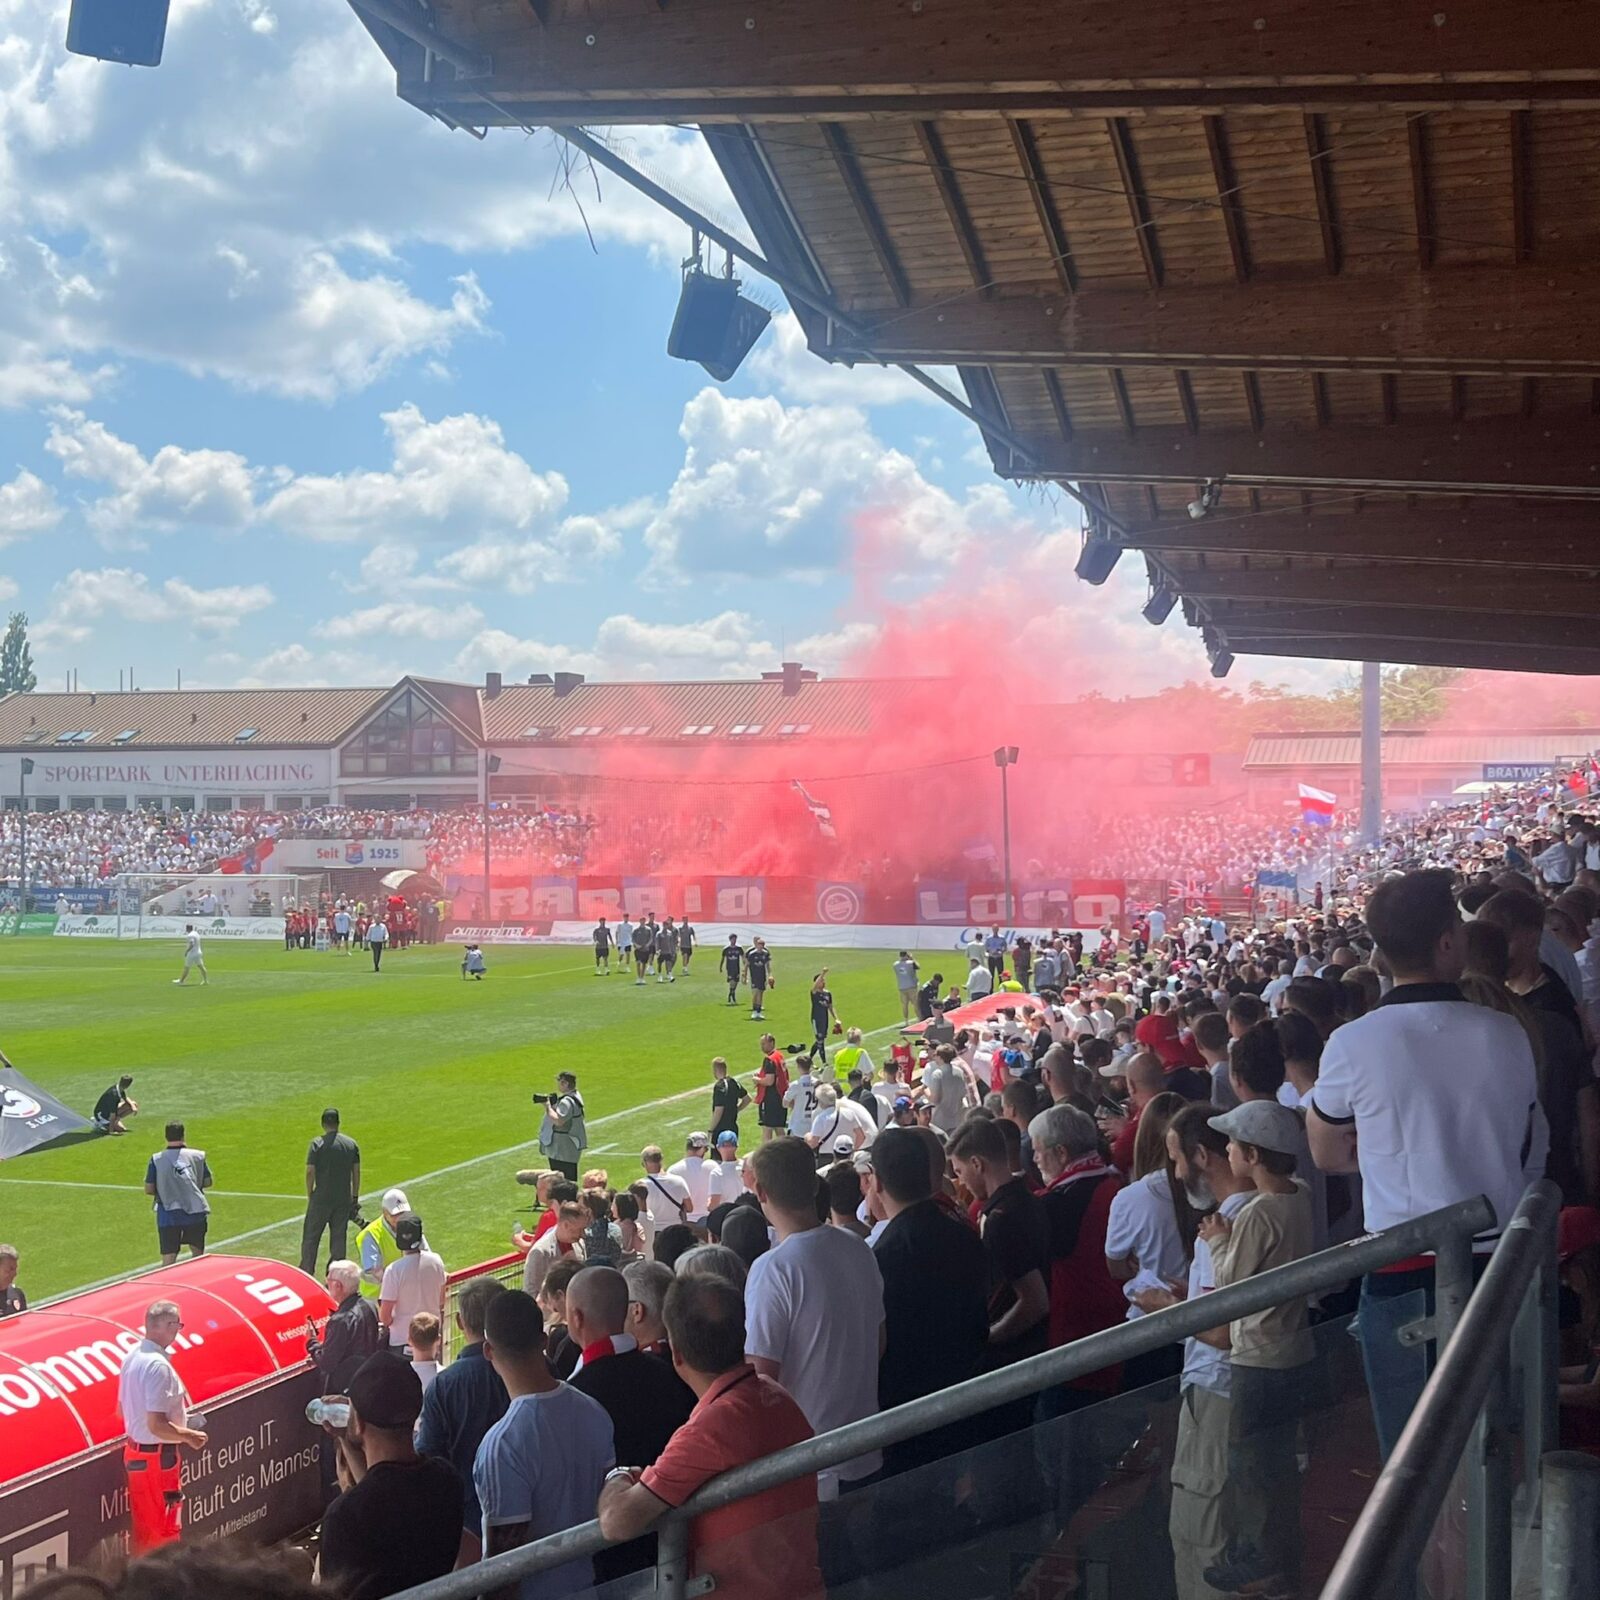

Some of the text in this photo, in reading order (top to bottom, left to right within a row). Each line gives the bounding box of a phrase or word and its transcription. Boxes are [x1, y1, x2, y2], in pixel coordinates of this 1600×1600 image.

[45, 764, 314, 782] SPORTPARK UNTERHACHING
[316, 847, 399, 860] Seit 1925
[56, 922, 116, 936] Alpenbauer
[184, 925, 245, 936] lpenbauer
[101, 1419, 279, 1523] Mit äuft eure IT.
[188, 1484, 225, 1525] läuft
[229, 1474, 255, 1504] die
[219, 1503, 268, 1539] Mittelstand
